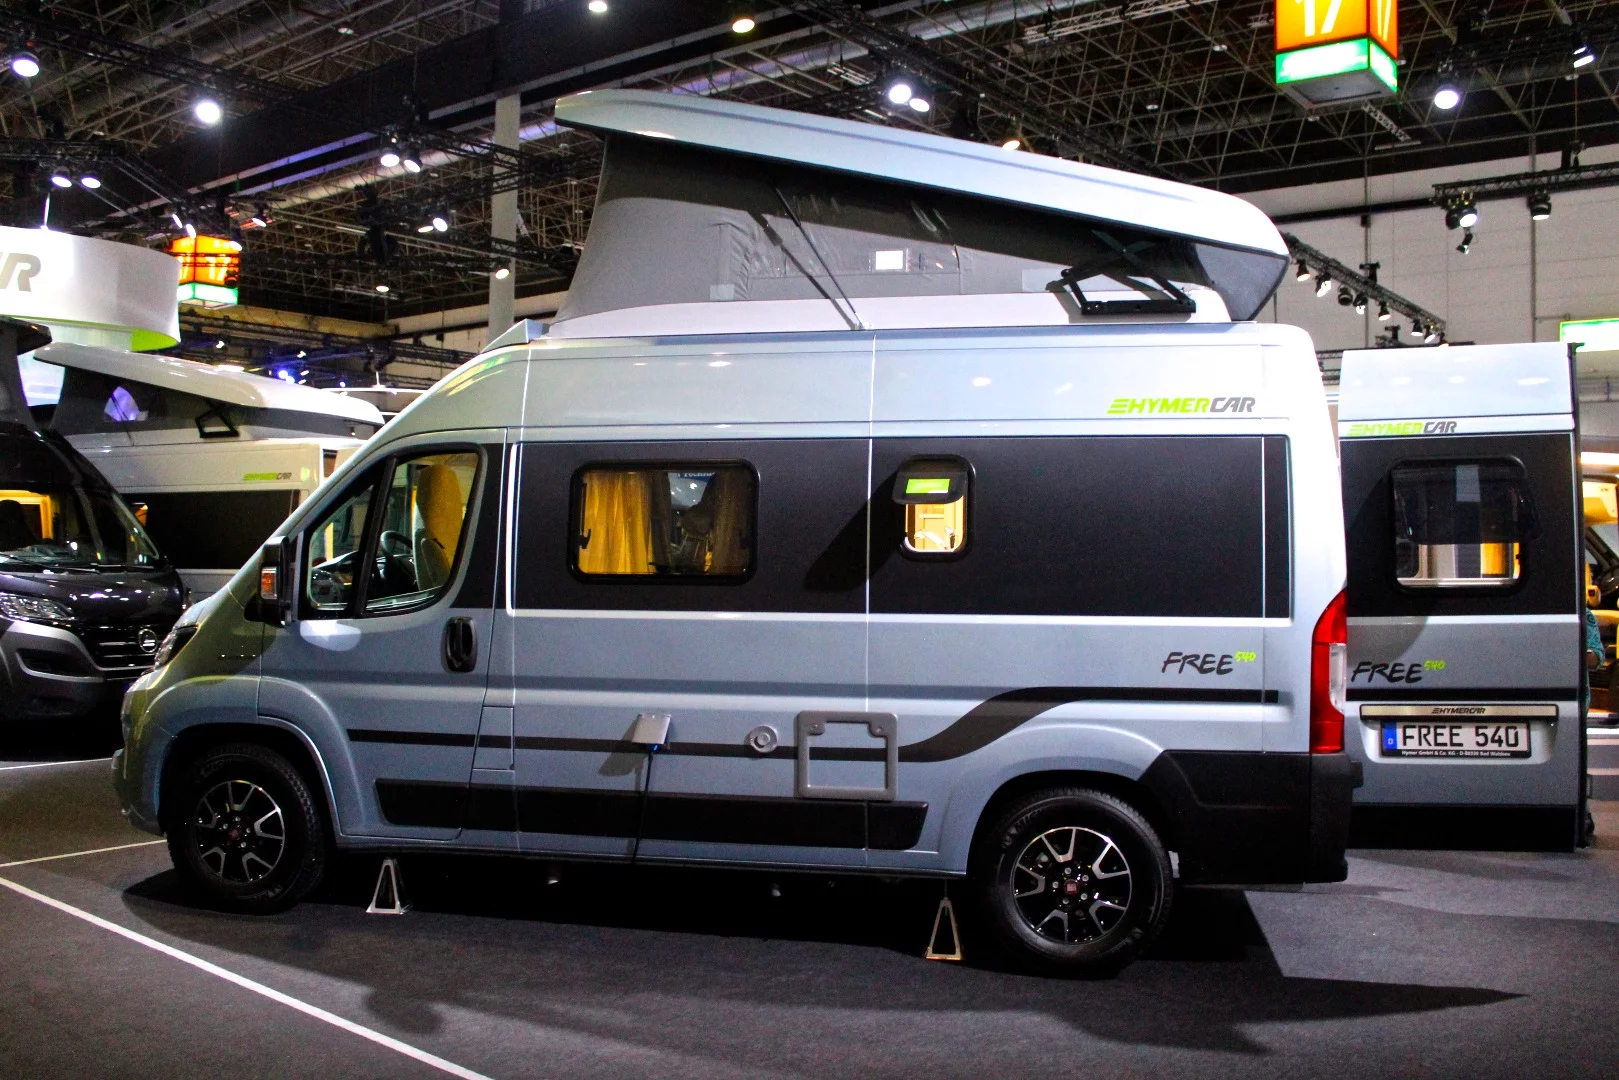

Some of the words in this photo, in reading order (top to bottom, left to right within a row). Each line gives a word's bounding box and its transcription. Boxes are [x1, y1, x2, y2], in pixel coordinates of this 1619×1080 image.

[1295, 0, 1343, 37] 17
[1161, 651, 1234, 675] FREE
[1351, 661, 1423, 683] FREE
[1402, 724, 1464, 747] FREE
[1474, 725, 1519, 748] 540
